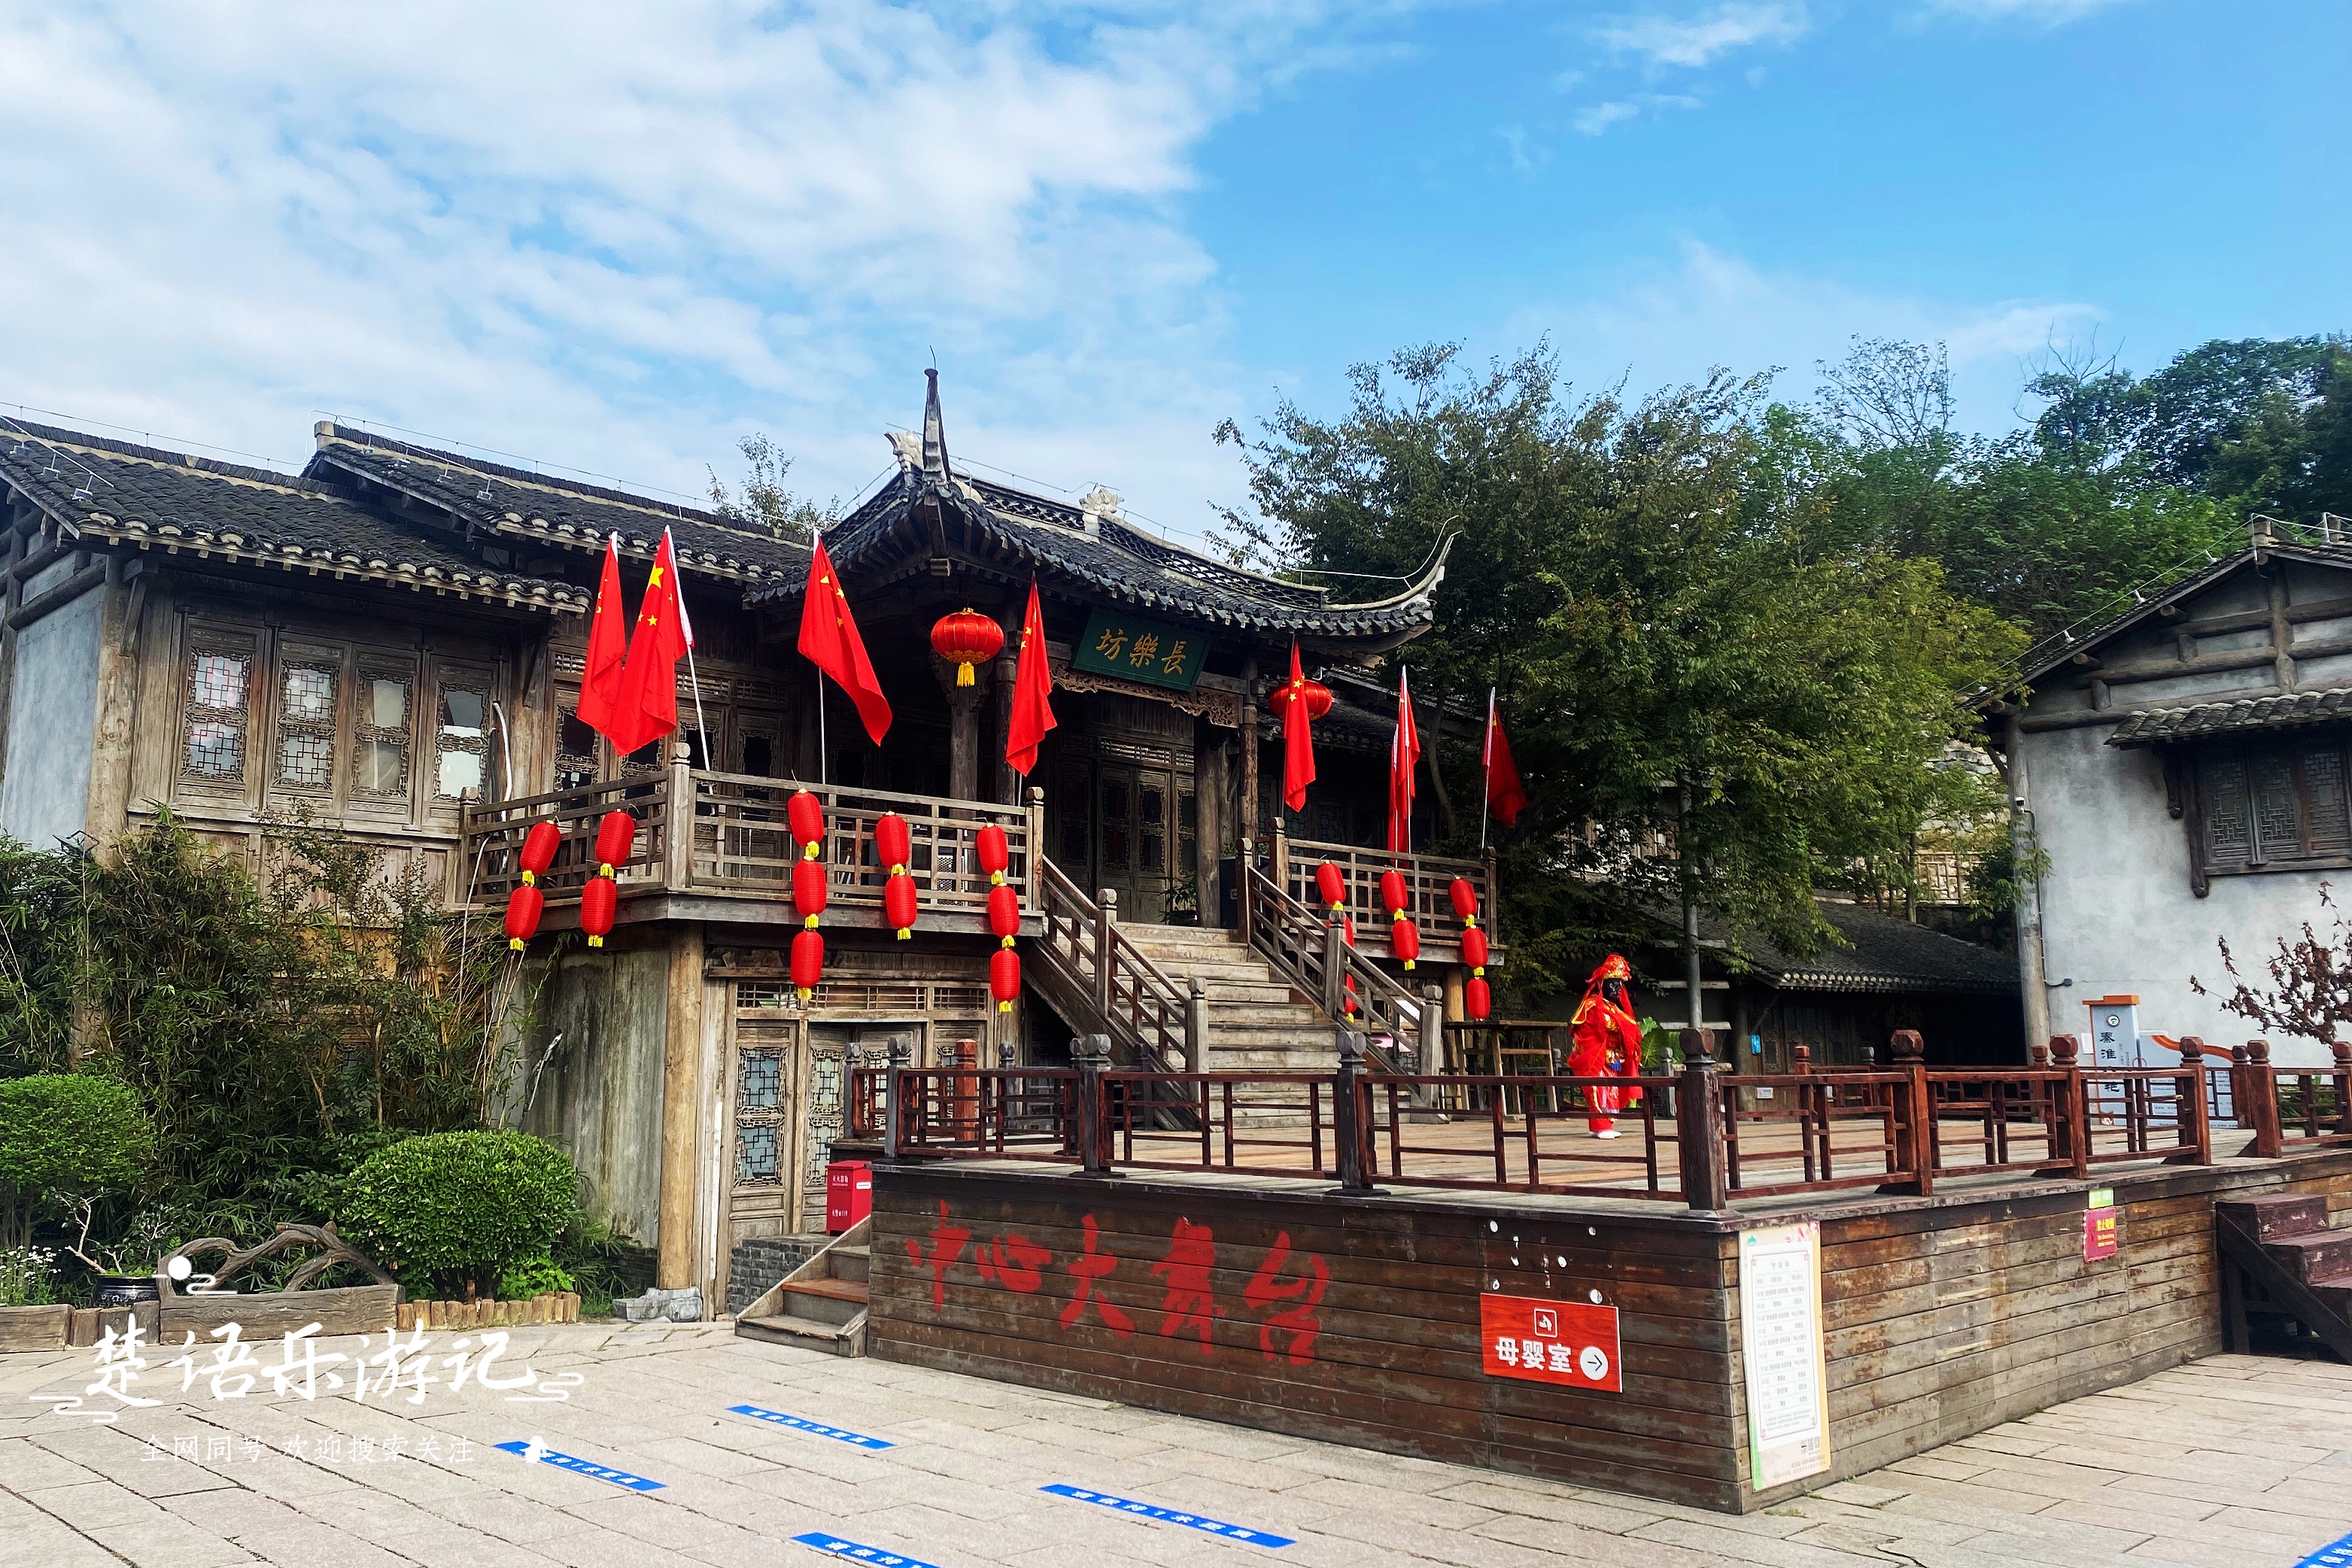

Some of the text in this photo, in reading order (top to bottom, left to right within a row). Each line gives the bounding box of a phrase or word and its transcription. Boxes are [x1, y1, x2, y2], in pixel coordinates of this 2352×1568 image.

[1095, 628, 1187, 675] 長樂坊
[905, 1199, 1329, 1366] 中心大舞台
[1495, 1337, 1573, 1373] 母婴室
